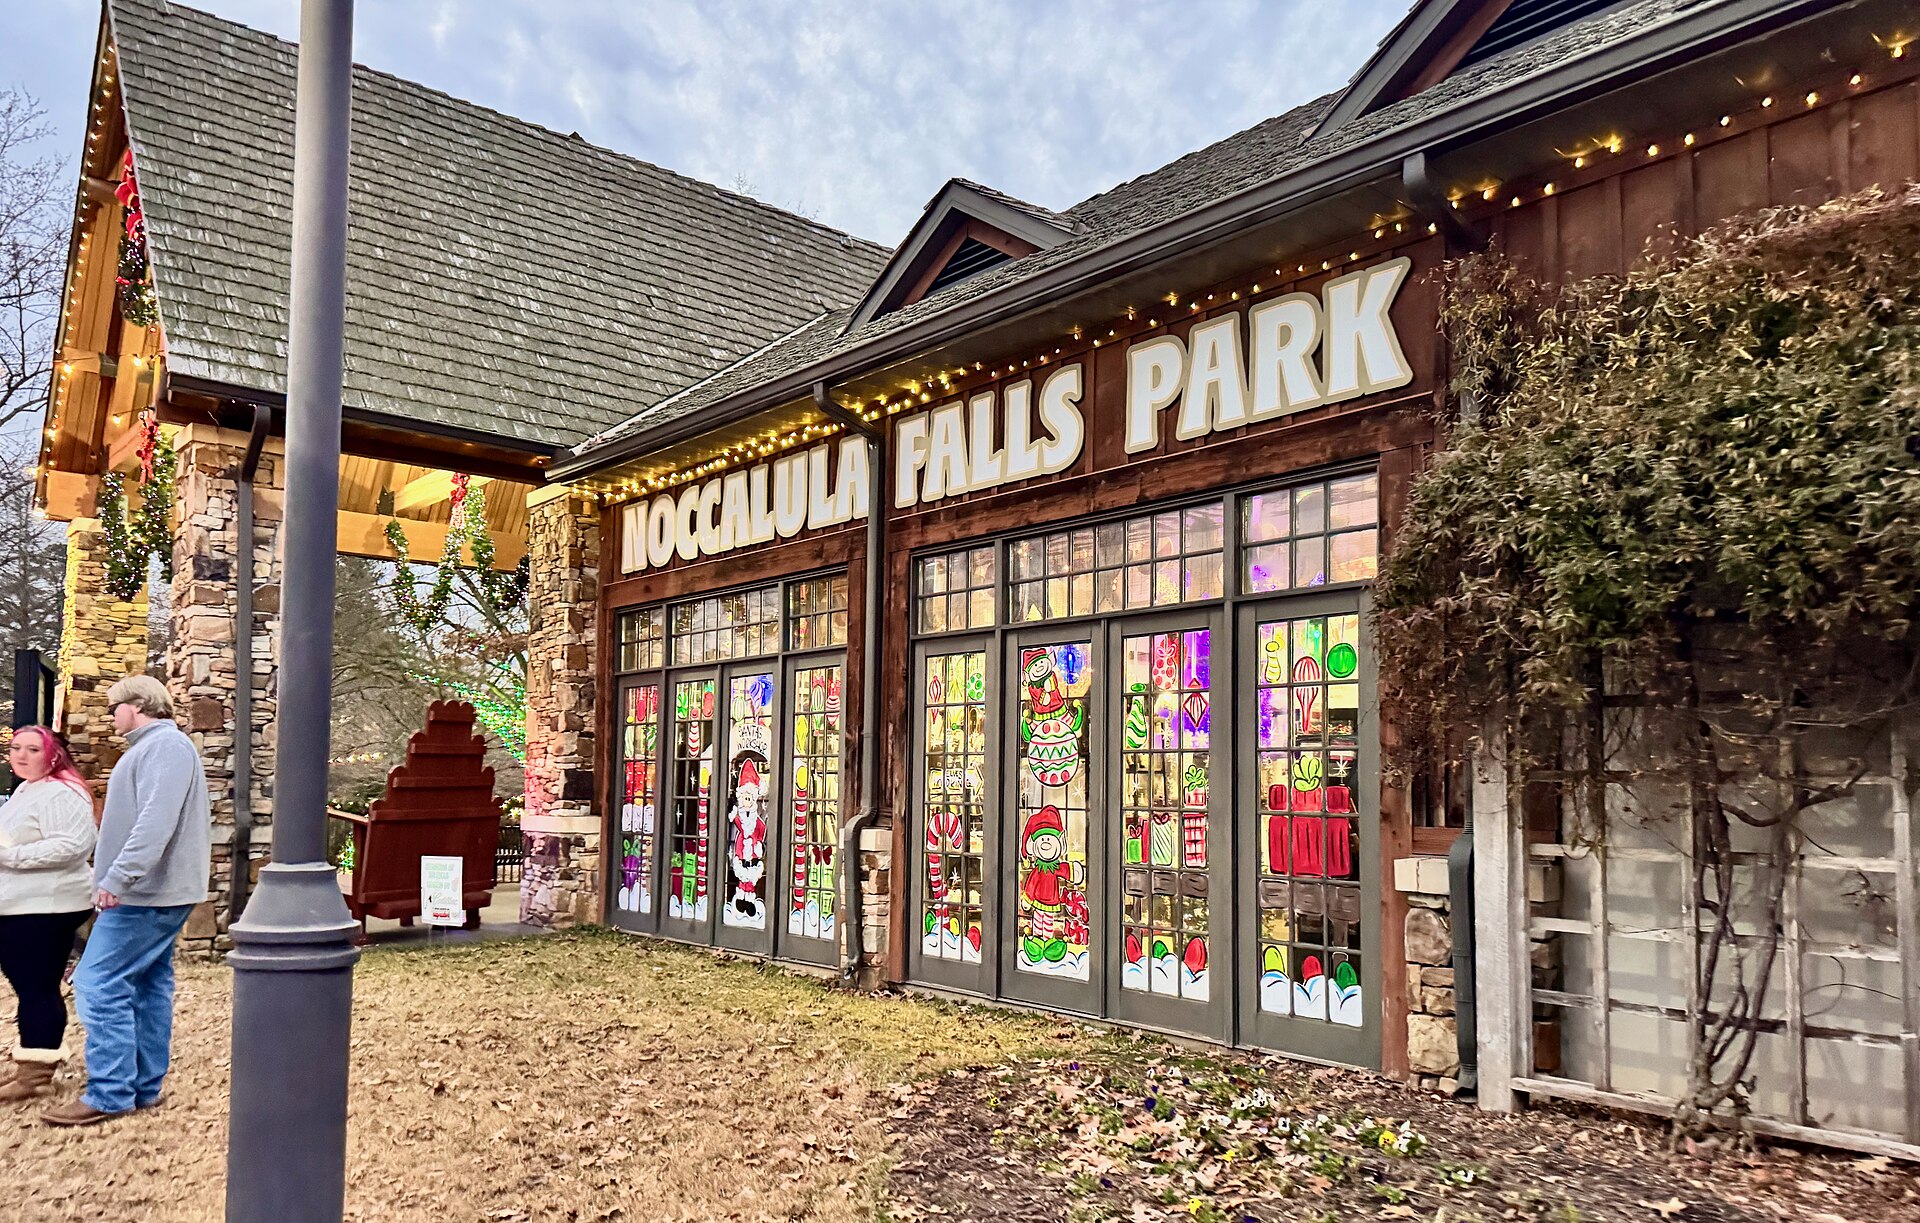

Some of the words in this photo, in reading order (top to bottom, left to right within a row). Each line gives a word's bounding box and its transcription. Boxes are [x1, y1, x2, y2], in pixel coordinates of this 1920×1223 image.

[621, 433, 869, 574] NOCCALULA
[895, 363, 1084, 509] FALLS
[1125, 256, 1413, 454] PARK
